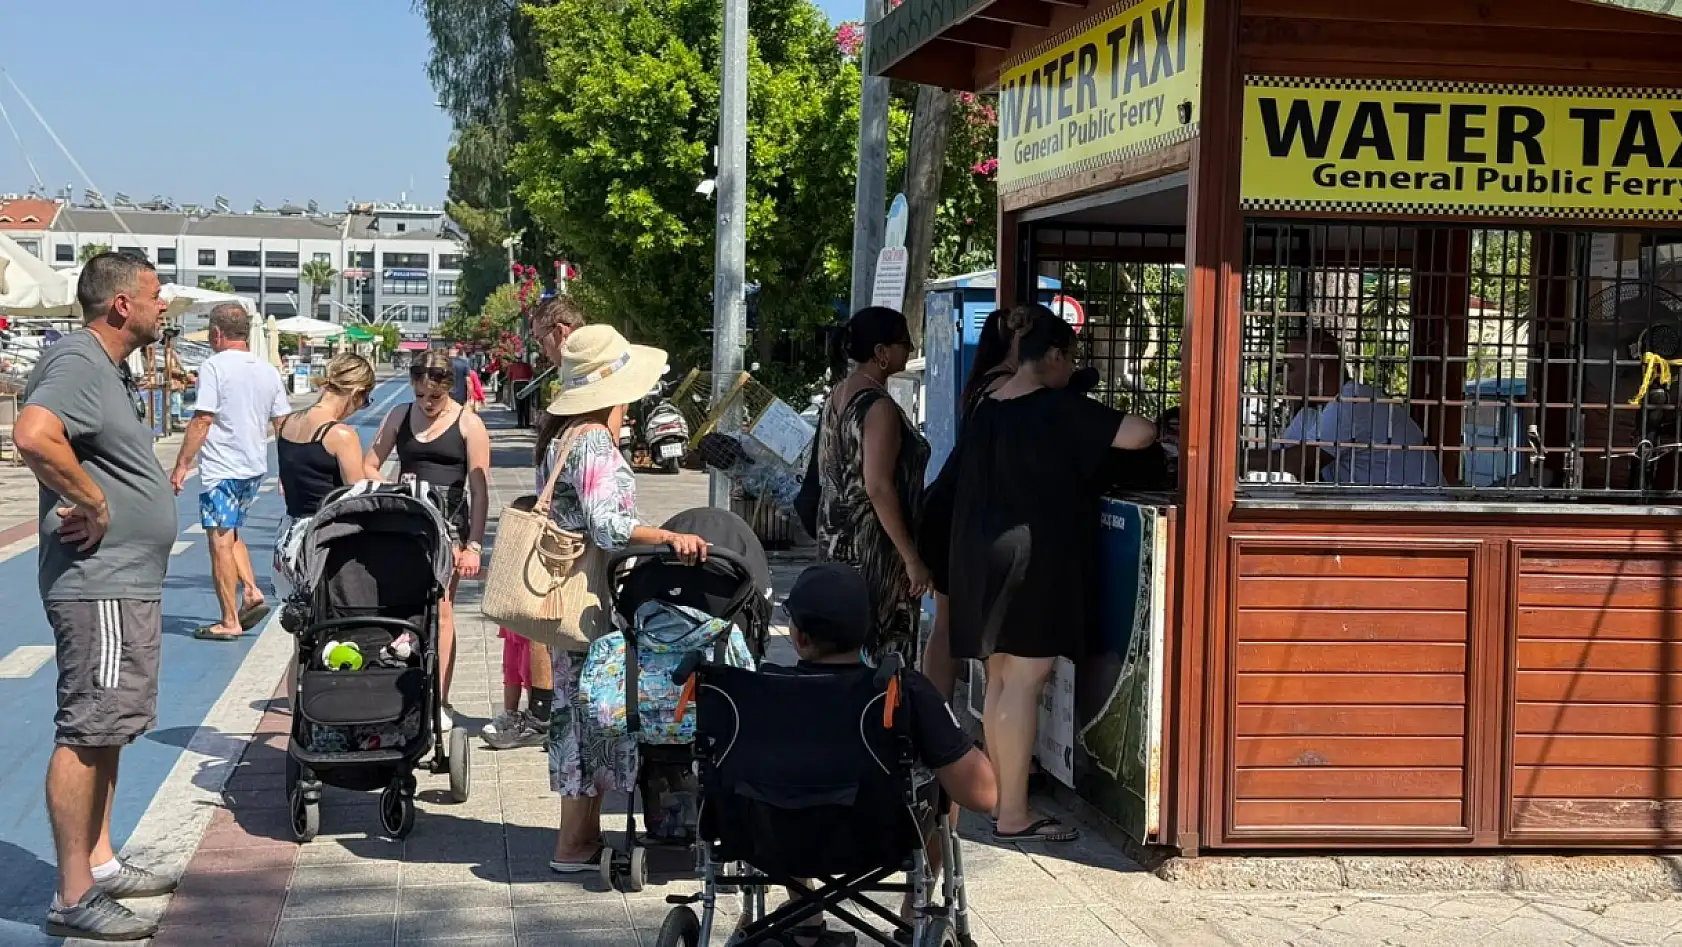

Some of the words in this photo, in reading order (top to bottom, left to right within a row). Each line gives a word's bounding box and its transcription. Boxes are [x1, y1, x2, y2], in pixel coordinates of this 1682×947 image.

[1001, 43, 1098, 142] WATER
[1107, 0, 1187, 100] TAXI
[1014, 124, 1064, 165] General
[1068, 107, 1116, 148] Public
[1119, 94, 1165, 130] Ferry
[1258, 98, 1546, 165] WATER
[1569, 108, 1682, 168] TA
[1312, 163, 1464, 191] General
[1477, 167, 1592, 194] Public
[1604, 171, 1682, 204] Ferr
